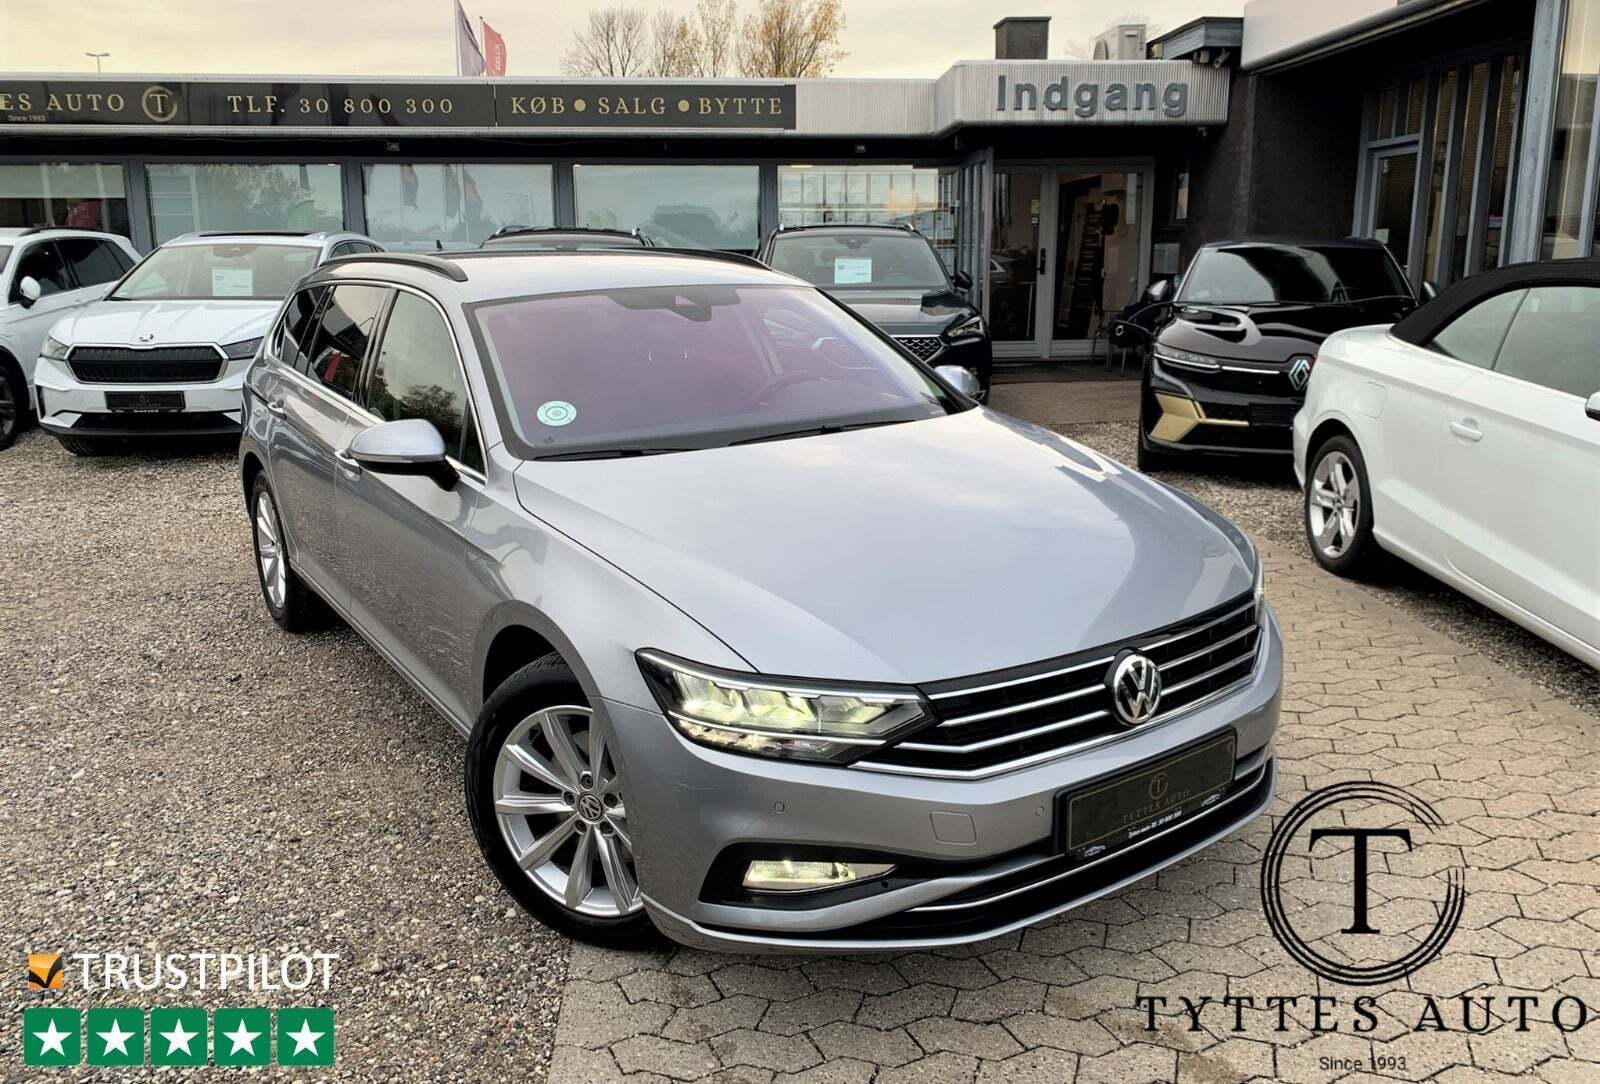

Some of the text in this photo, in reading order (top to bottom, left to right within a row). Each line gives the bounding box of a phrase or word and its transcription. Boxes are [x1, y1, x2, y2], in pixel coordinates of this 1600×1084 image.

[46, 93, 125, 112] AUTO
[227, 95, 453, 114] TLF. 30 800 300
[511, 96, 783, 115] KØB SALG BYTTE
[996, 75, 1189, 118] Indgang
